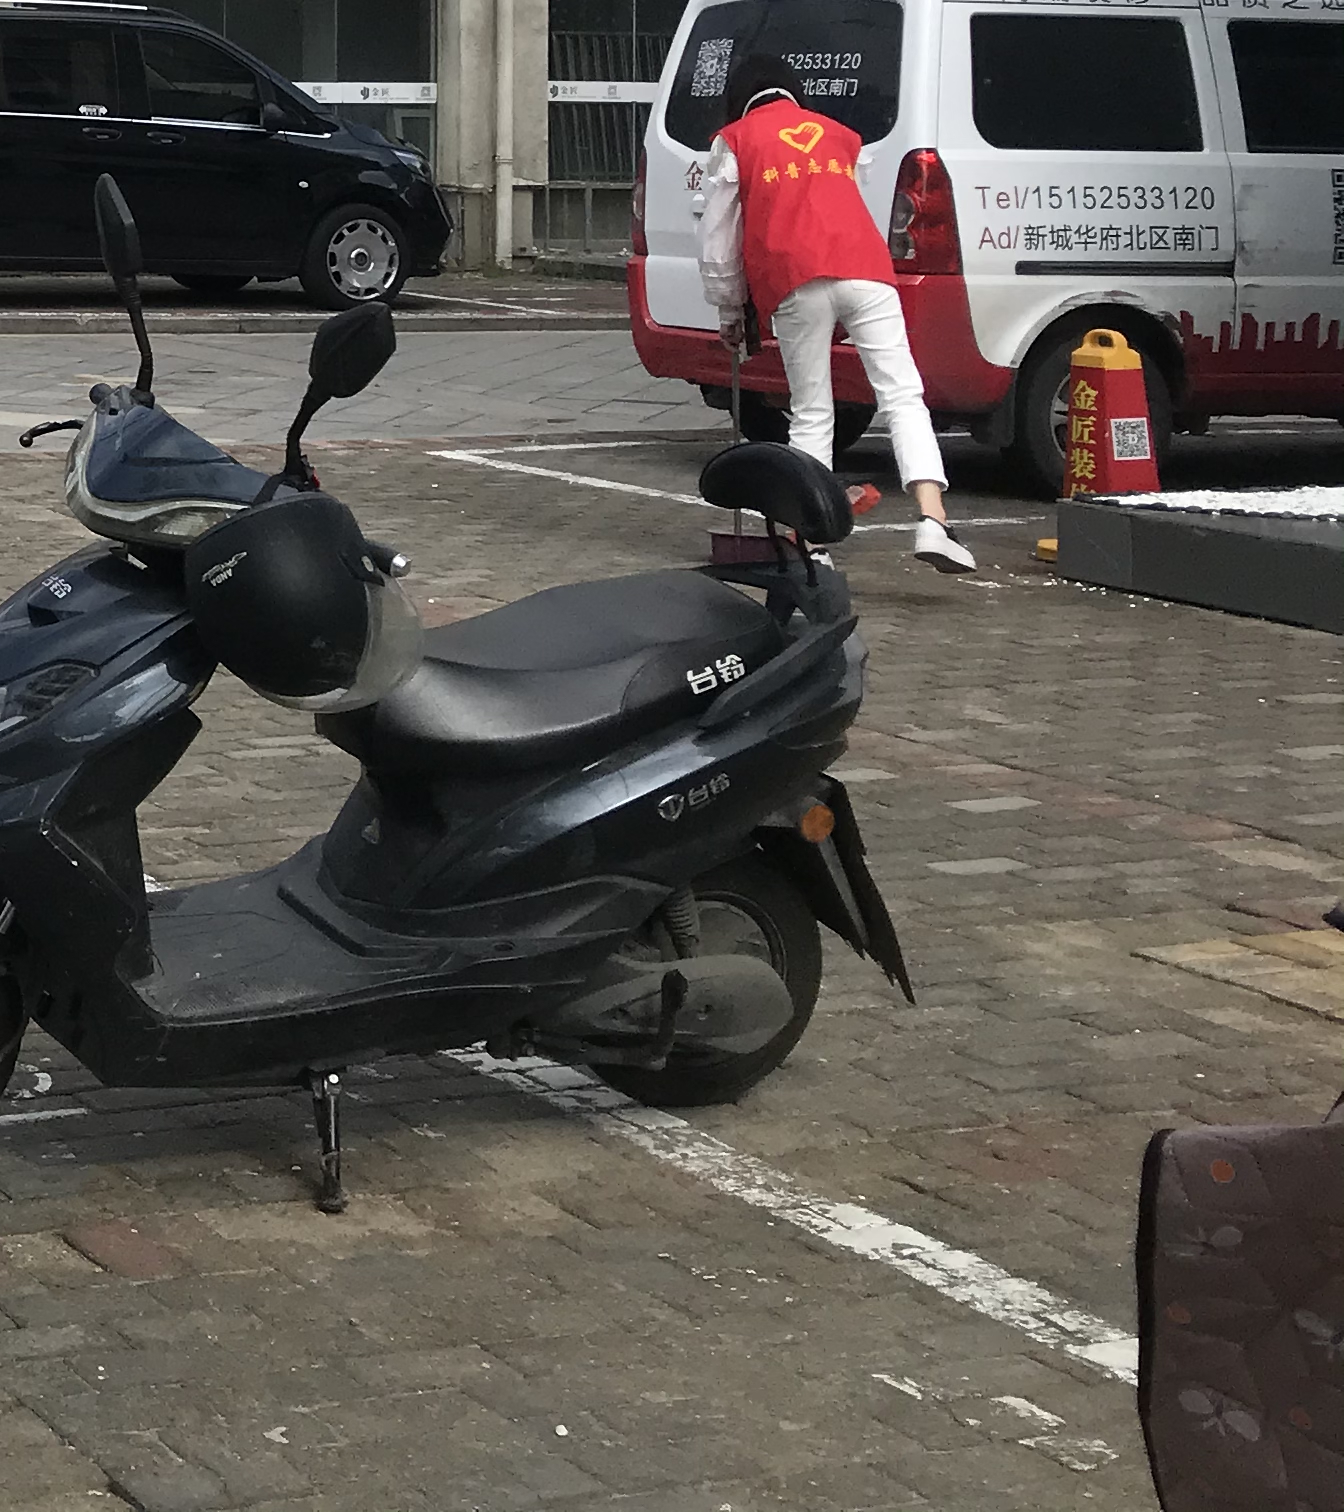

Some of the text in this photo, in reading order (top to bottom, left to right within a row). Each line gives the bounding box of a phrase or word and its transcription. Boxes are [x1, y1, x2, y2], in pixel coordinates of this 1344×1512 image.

[781, 52, 862, 71] 52533120
[800, 77, 859, 97] 北区南门
[974, 185, 1216, 211] Tel/15152533120
[686, 654, 746, 695] 台铃
[688, 773, 731, 807] 台铃
